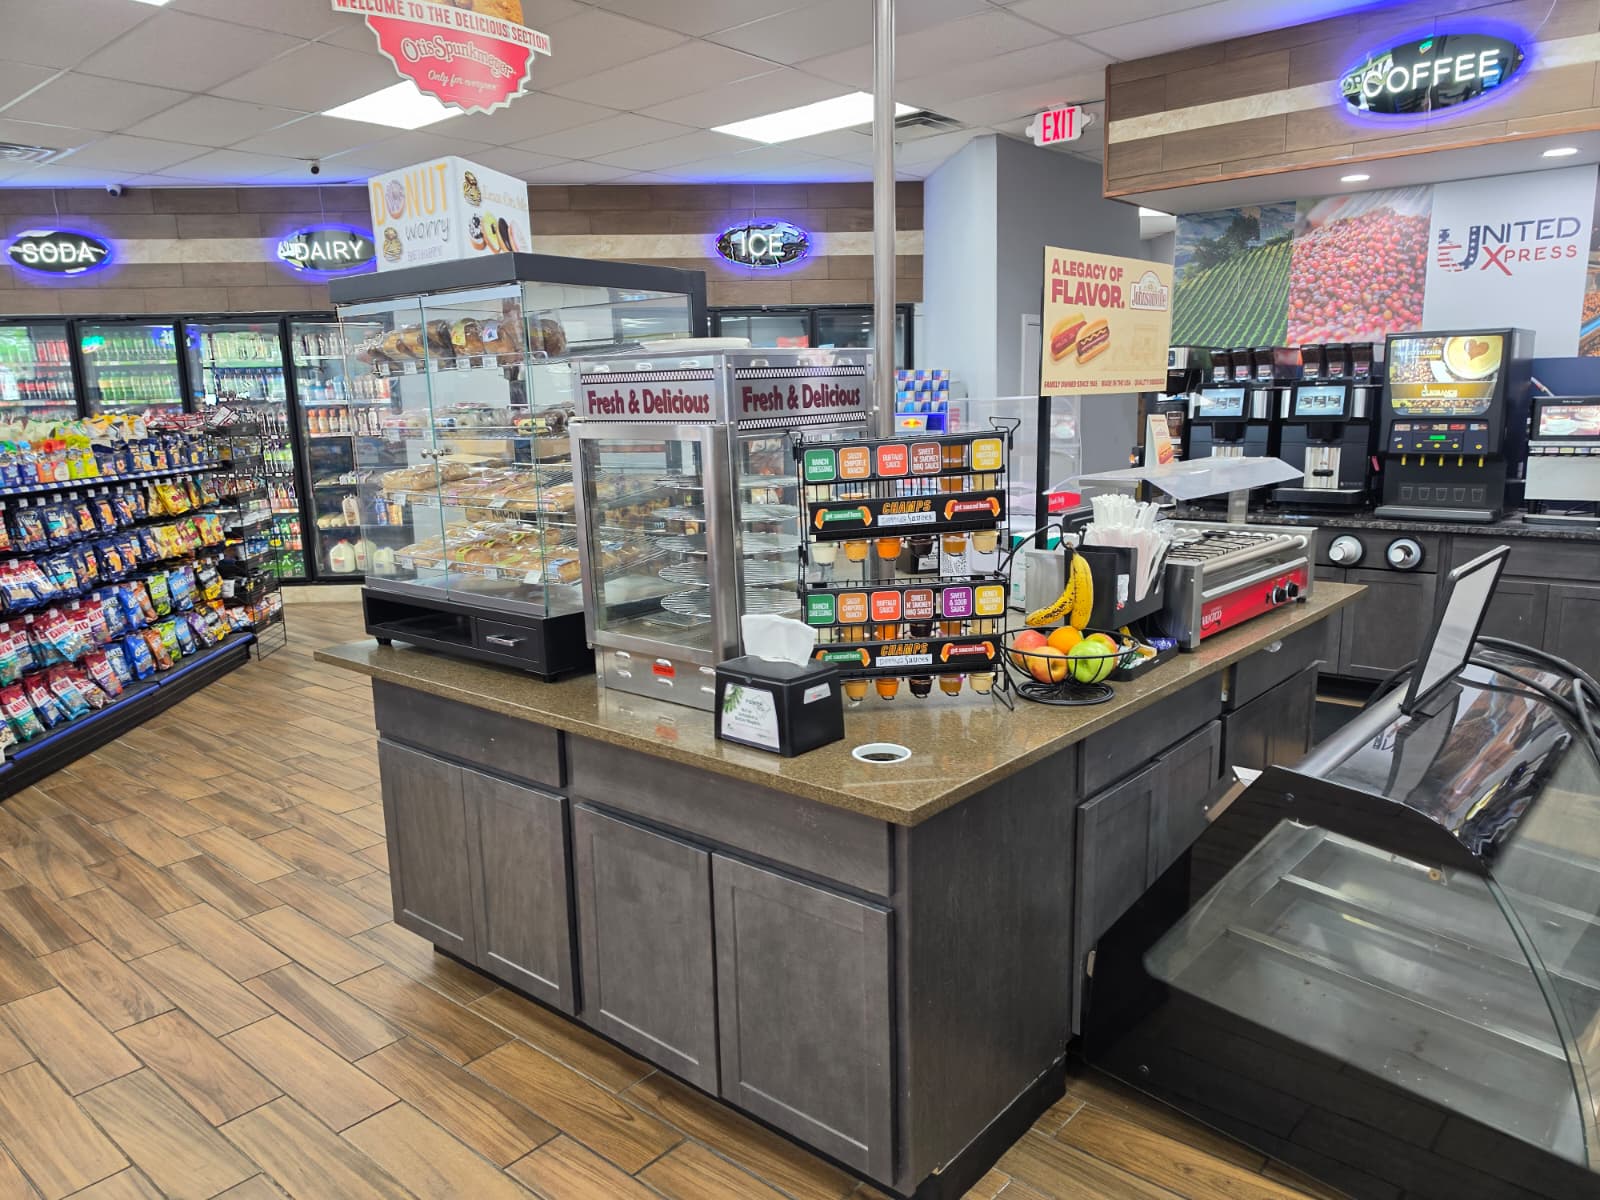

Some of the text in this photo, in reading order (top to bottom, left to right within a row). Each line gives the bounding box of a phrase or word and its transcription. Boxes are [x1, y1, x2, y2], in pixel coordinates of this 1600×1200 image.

[336, 0, 548, 50] WELCOME TO THE DELICIOUS SECTION
[401, 34, 514, 79] Otis Spunkmeyer
[428, 70, 450, 87] Only
[1362, 49, 1500, 98] COFFEE
[1043, 108, 1076, 143] EXIT
[372, 162, 448, 227] DONUT
[405, 216, 450, 242] worry
[22, 241, 97, 263] SODA
[295, 240, 363, 261] DAIRY
[741, 233, 785, 257] ICE
[1438, 216, 1581, 273] UNITED
[1051, 258, 1124, 282] A LEGACY OF
[1480, 244, 1578, 276] XPRESS
[1051, 278, 1125, 309] FLAVOR.
[1131, 284, 1167, 307] Johnsonville
[587, 388, 710, 415] Fresh & Delicious
[742, 383, 861, 413] Fresh & Delicious
[918, 447, 934, 455] SWEET
[882, 499, 932, 515] CHAMPS
[949, 591, 966, 599] SWEET
[954, 598, 968, 606] SOUR
[950, 605, 965, 613] SAUCE
[880, 642, 929, 656] CHAMPS
